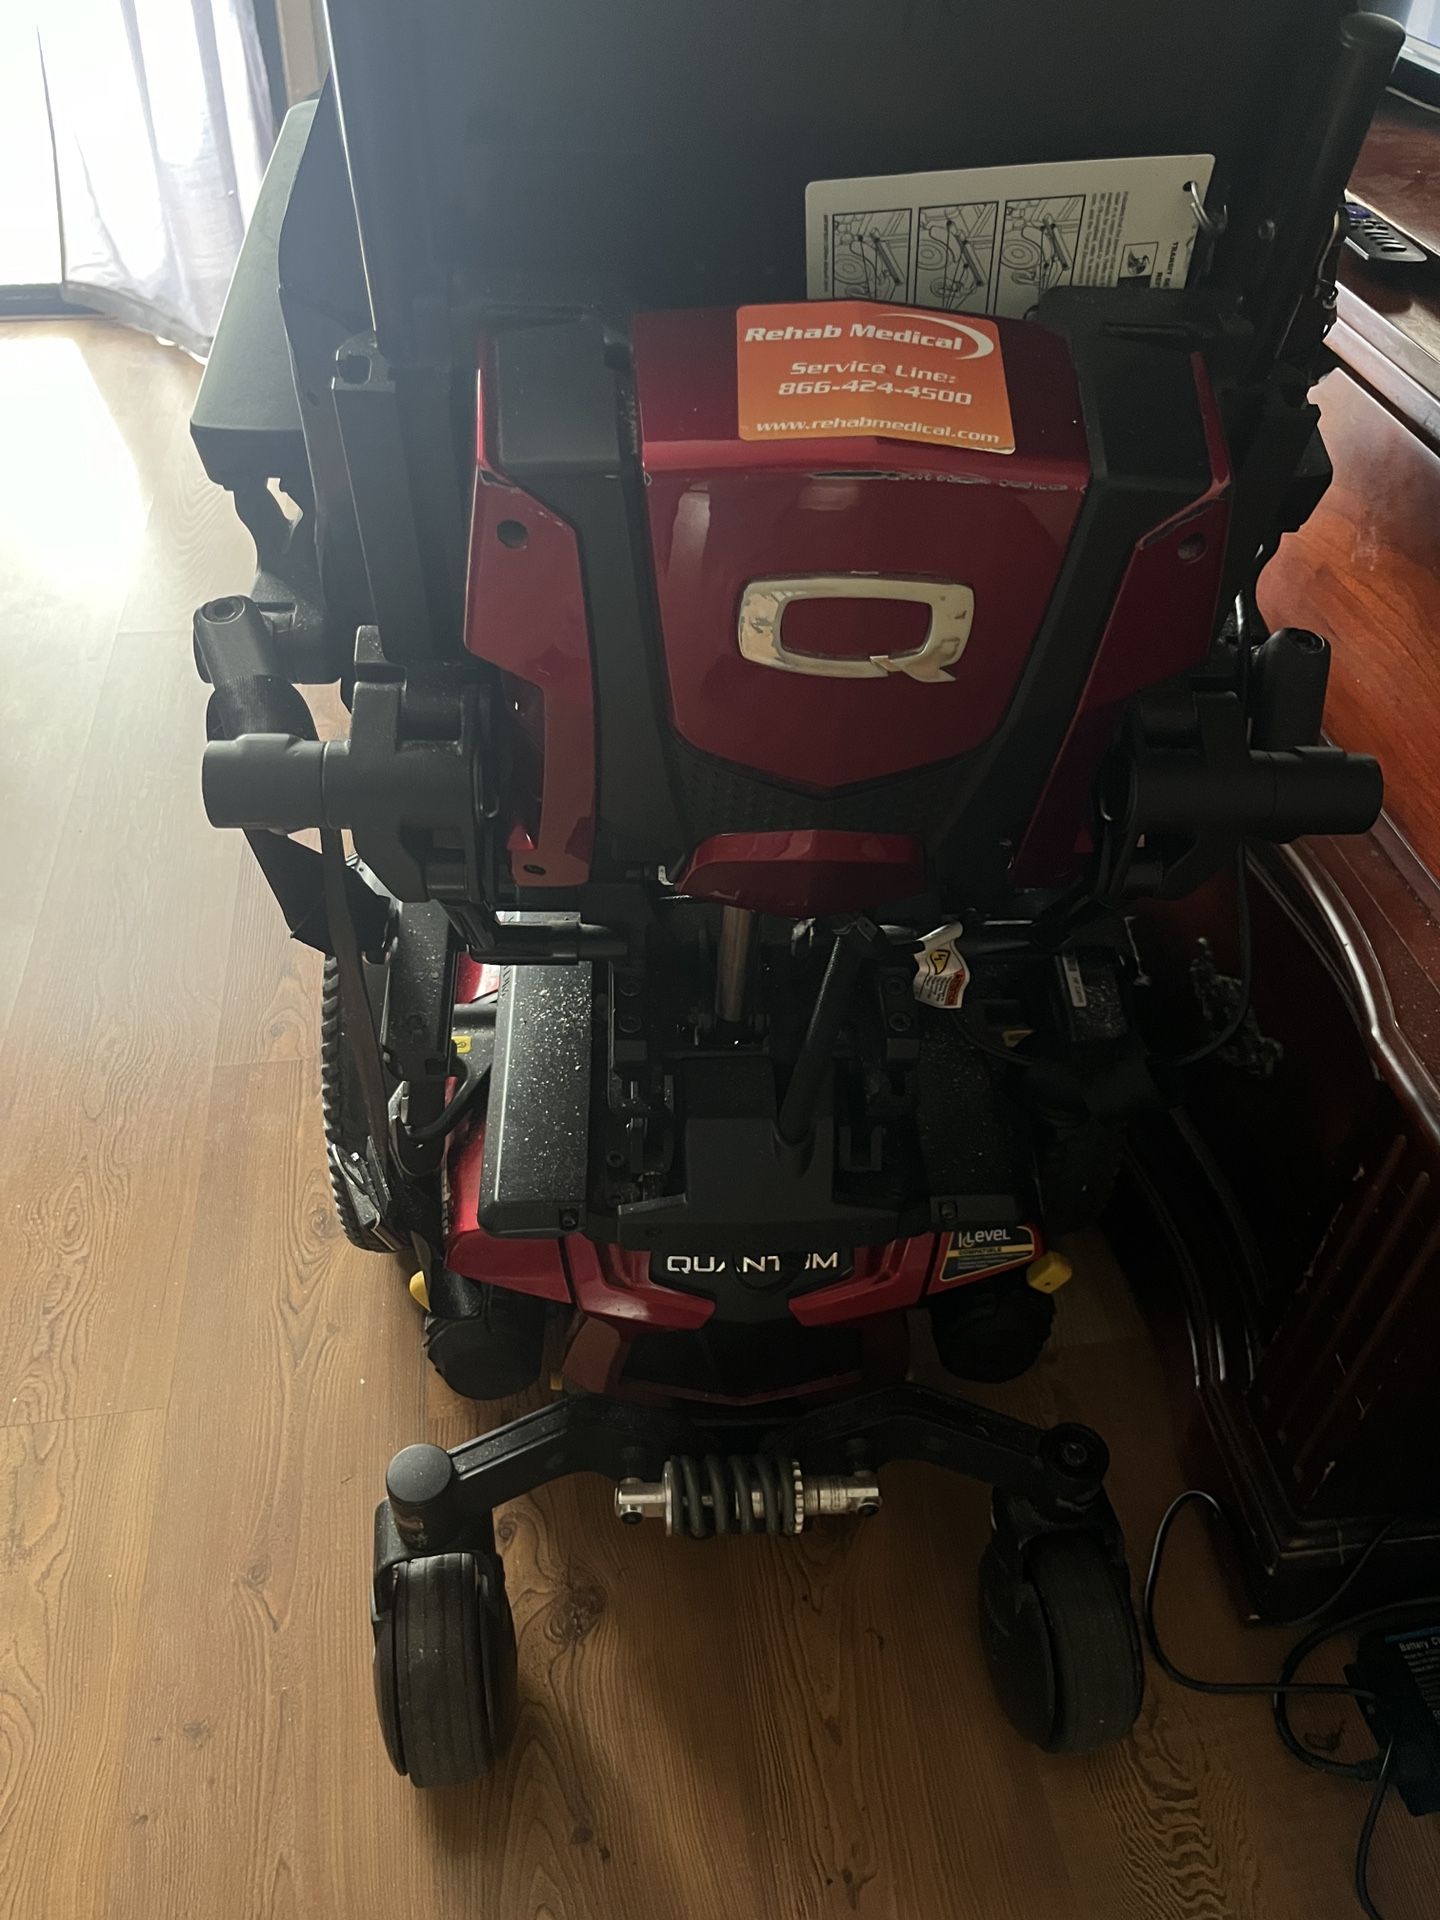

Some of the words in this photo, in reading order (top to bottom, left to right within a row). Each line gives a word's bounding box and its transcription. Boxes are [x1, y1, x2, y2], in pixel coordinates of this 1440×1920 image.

[745, 324, 842, 343] Rehab
[849, 323, 963, 351] Medical
[790, 360, 887, 375] Service
[895, 365, 957, 384] Line:
[778, 379, 973, 406] 866-424-4500
[756, 416, 1000, 444] www.rehabmedical.com
[667, 1251, 839, 1274] QUNTM
